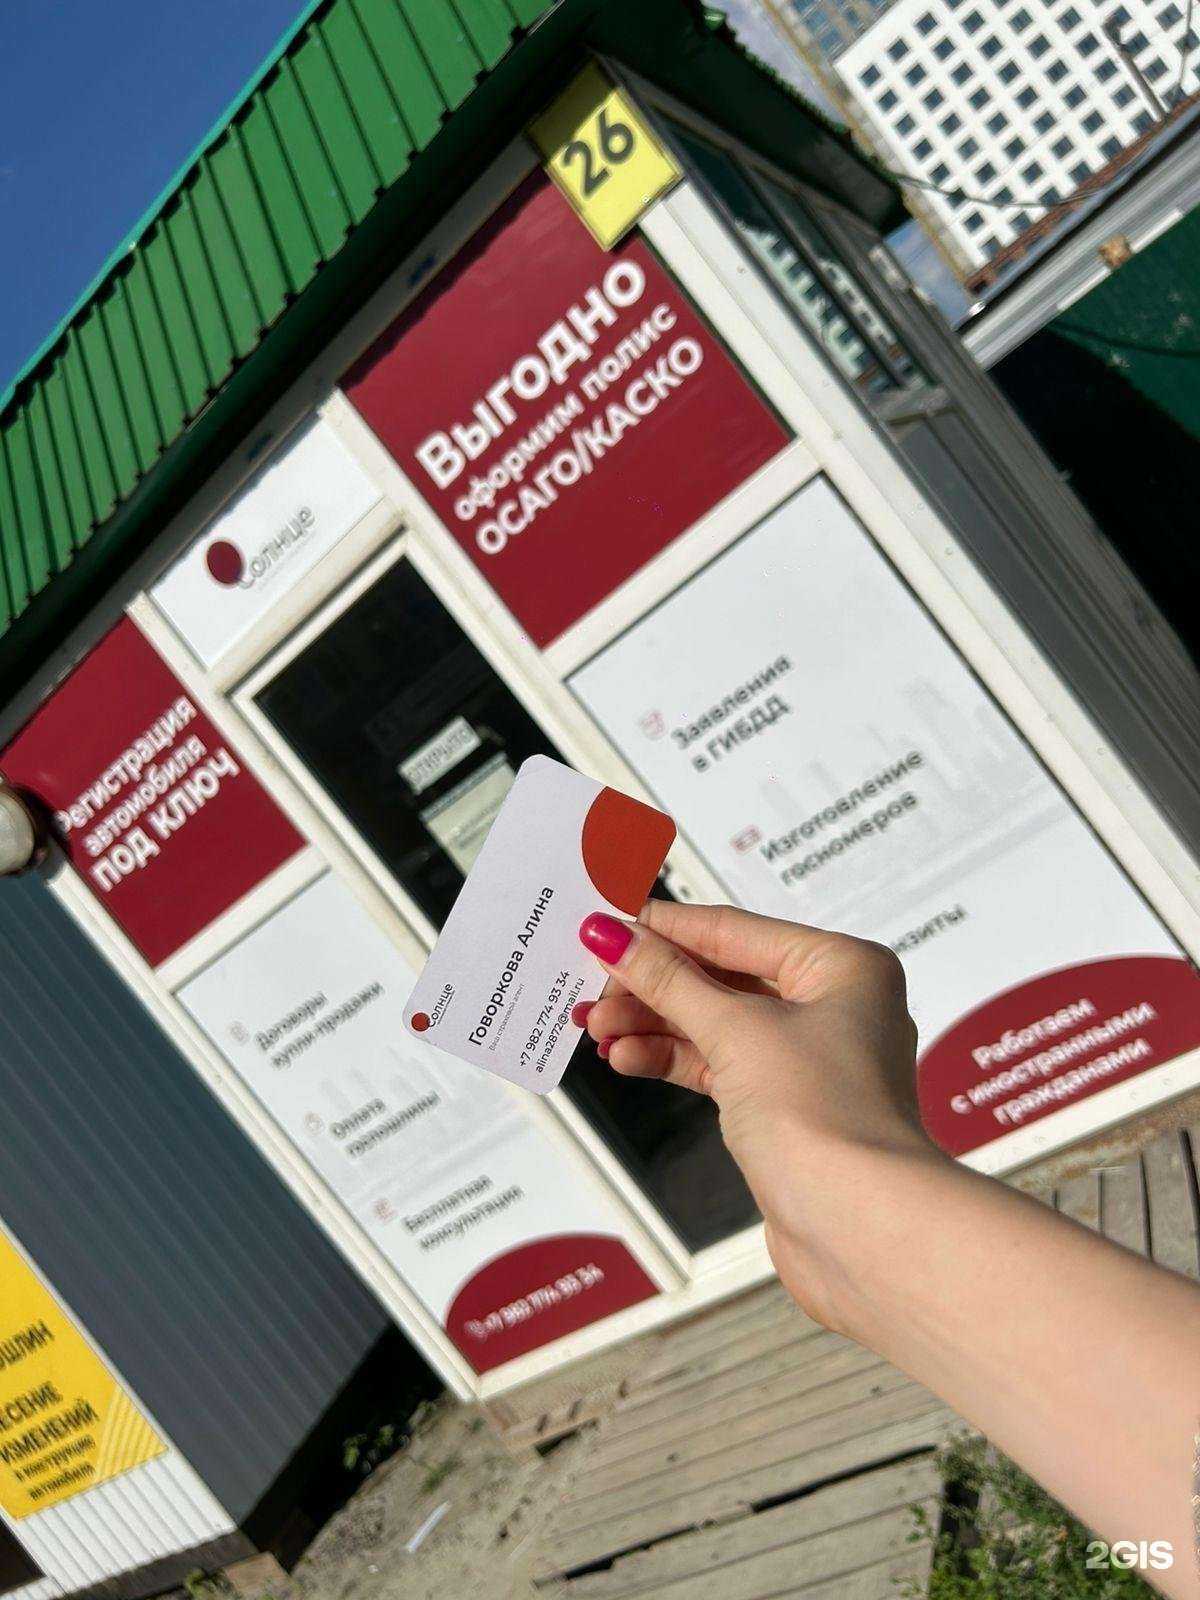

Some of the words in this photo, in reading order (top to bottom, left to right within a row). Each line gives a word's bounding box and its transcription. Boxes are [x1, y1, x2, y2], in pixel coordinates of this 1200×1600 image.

[562, 107, 634, 196] 26
[454, 392, 585, 521] оформим
[578, 302, 678, 401] полис
[475, 336, 704, 555] ОСАГО/КАСКО
[670, 654, 793, 749] Заявления
[691, 752, 711, 774] в
[706, 693, 793, 762] ГИБДД
[82, 734, 208, 857] автомобиля
[759, 750, 924, 864] Изготовление
[779, 789, 919, 887] госномеров
[467, 949, 525, 1047] Говоркова
[516, 885, 555, 948] Алина
[519, 1051, 531, 1067] +7
[525, 1027, 544, 1052] 982
[536, 1004, 555, 1026] 774
[548, 986, 562, 1004] 93
[555, 970, 571, 988] 34
[535, 977, 586, 1074] alina2872@mail.ru
[950, 1094, 974, 1115] с
[966, 1001, 1159, 1107] иностранными
[970, 998, 1098, 1071] Работаем
[992, 1037, 1153, 1126] гражданами
